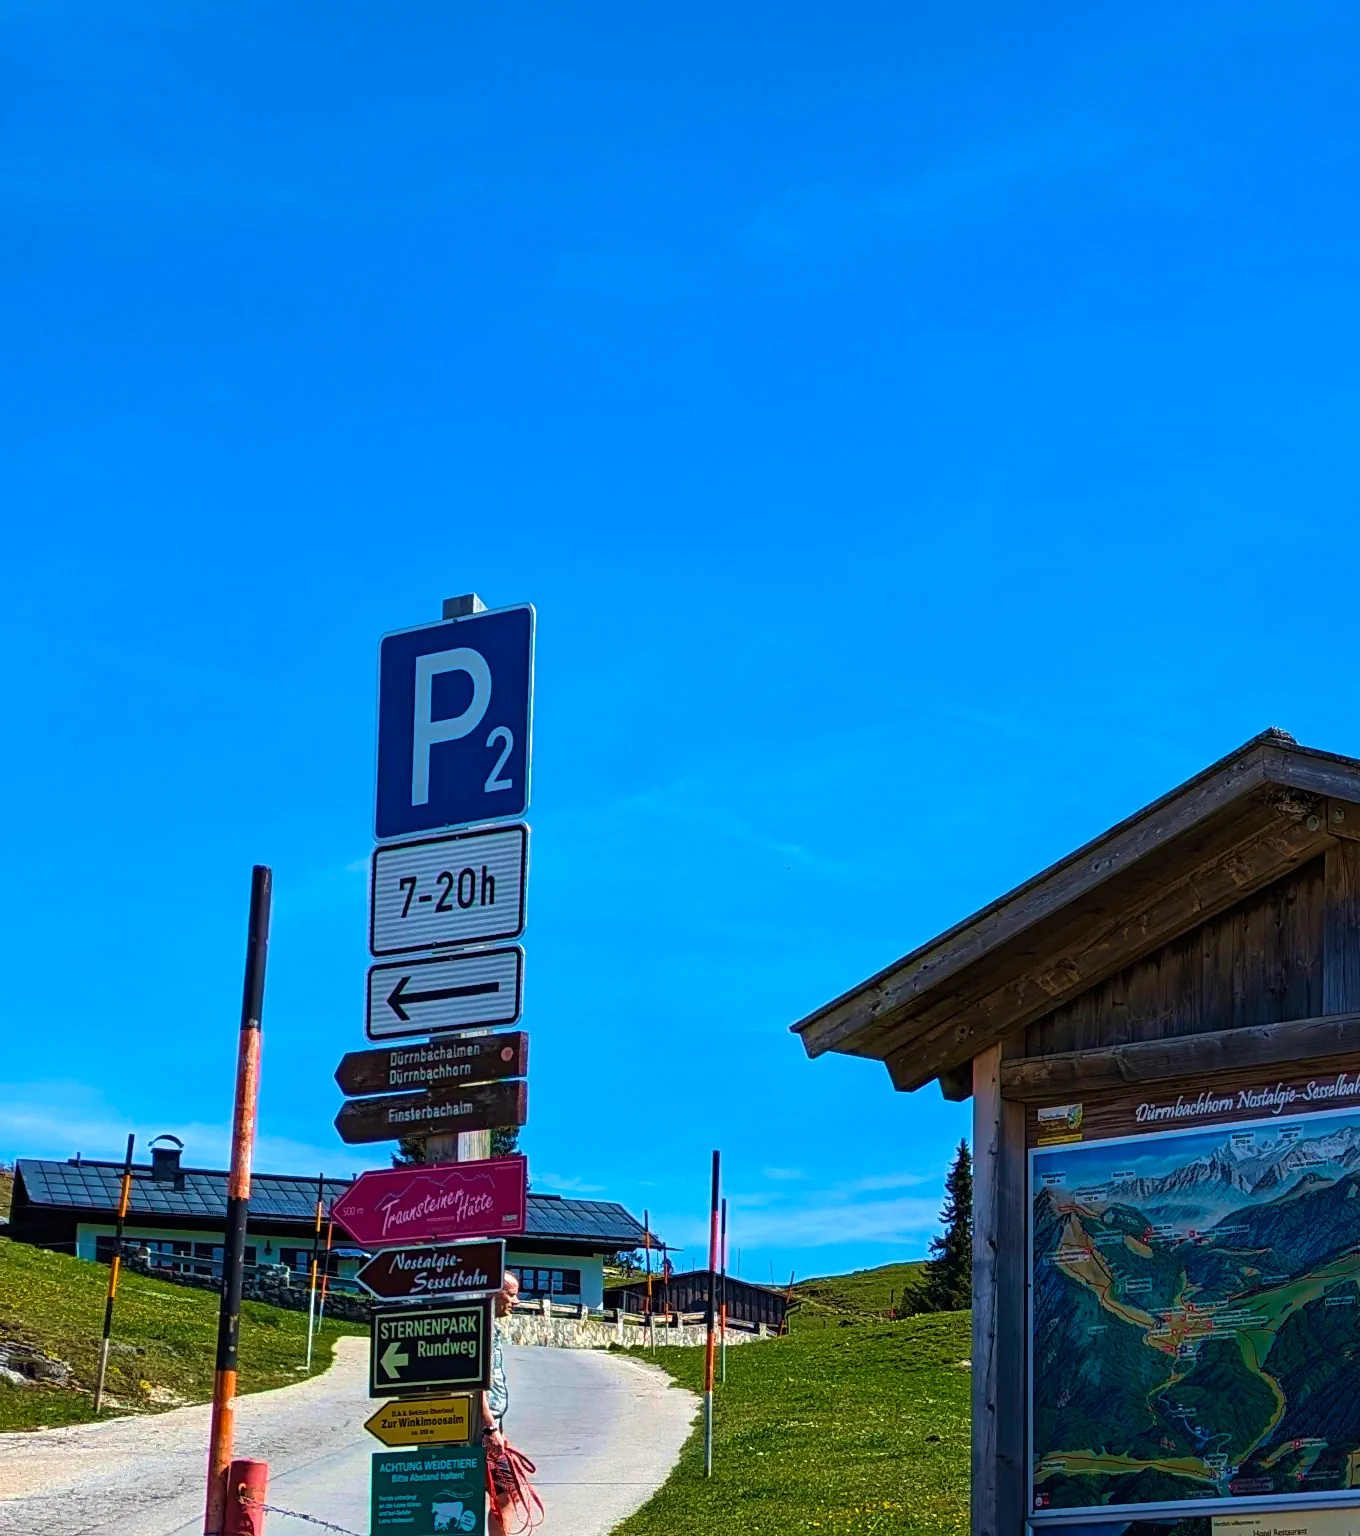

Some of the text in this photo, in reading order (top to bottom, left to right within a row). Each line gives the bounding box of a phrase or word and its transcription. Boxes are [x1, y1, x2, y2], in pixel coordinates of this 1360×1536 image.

[411, 647, 514, 806] P 2
[399, 866, 496, 918] 7-20h
[390, 1043, 480, 1067] Dürrnbachalmen
[389, 1063, 472, 1085] Dürrnbachhorn
[388, 1101, 473, 1123] Finsterbachalm
[1135, 1090, 1233, 1123] Dürrnbachhorn
[381, 1189, 464, 1236] Traunsteiner
[456, 1192, 493, 1222] Hütte
[388, 1252, 463, 1274] Nostalgie-
[409, 1268, 488, 1293] Sesselbahn
[380, 1315, 477, 1339] STERNENPARK
[417, 1337, 477, 1358] Rundweg
[380, 1458, 478, 1473] ACHTUNG WEIDETIERE
